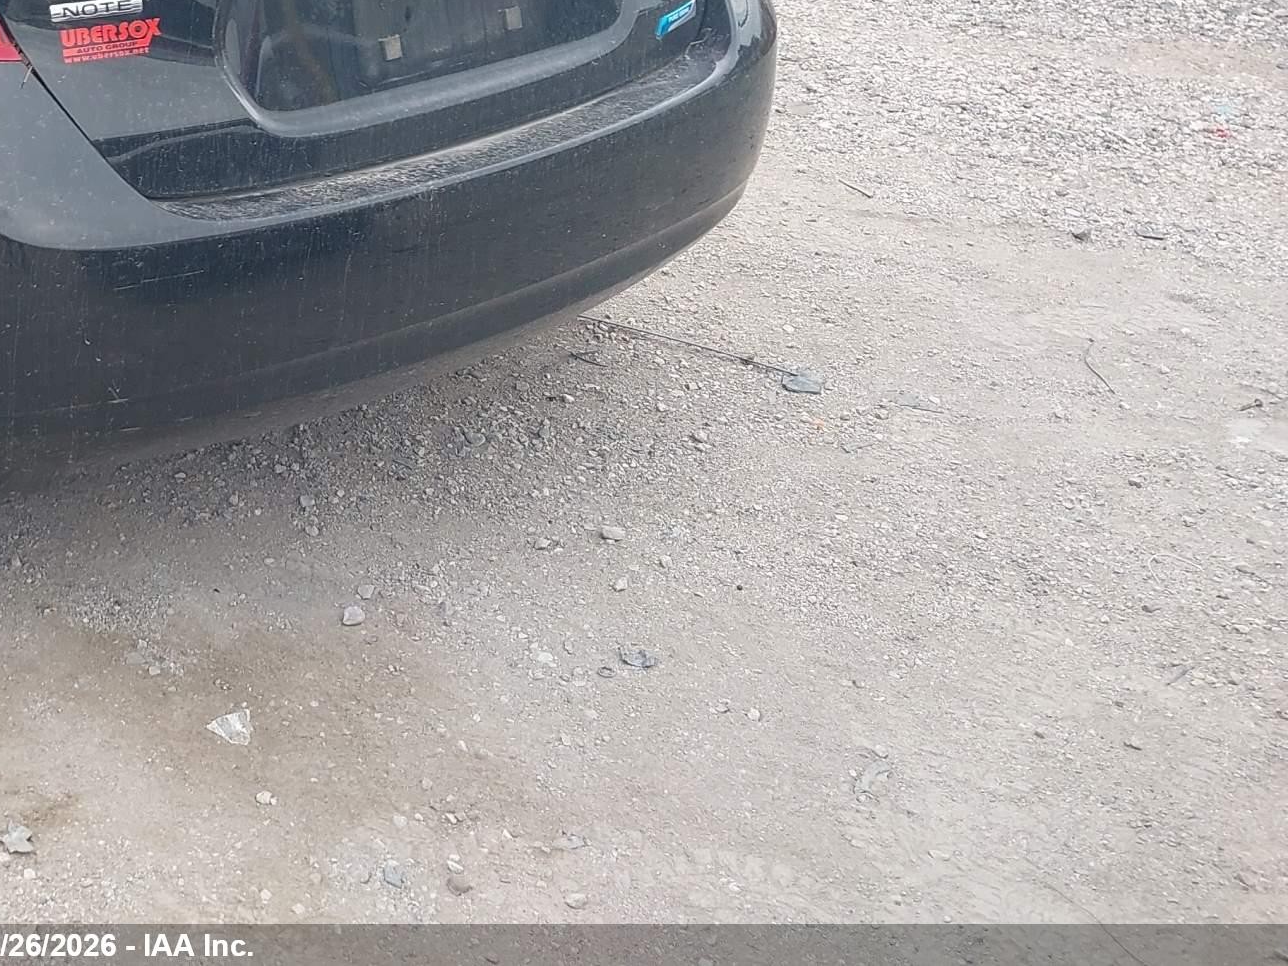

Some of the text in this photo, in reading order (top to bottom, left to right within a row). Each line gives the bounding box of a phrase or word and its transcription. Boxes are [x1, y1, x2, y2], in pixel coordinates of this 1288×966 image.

[62, 0, 133, 17] NOTE
[60, 17, 162, 47] UBERSOX
[76, 41, 138, 54] AUTO GROUP
